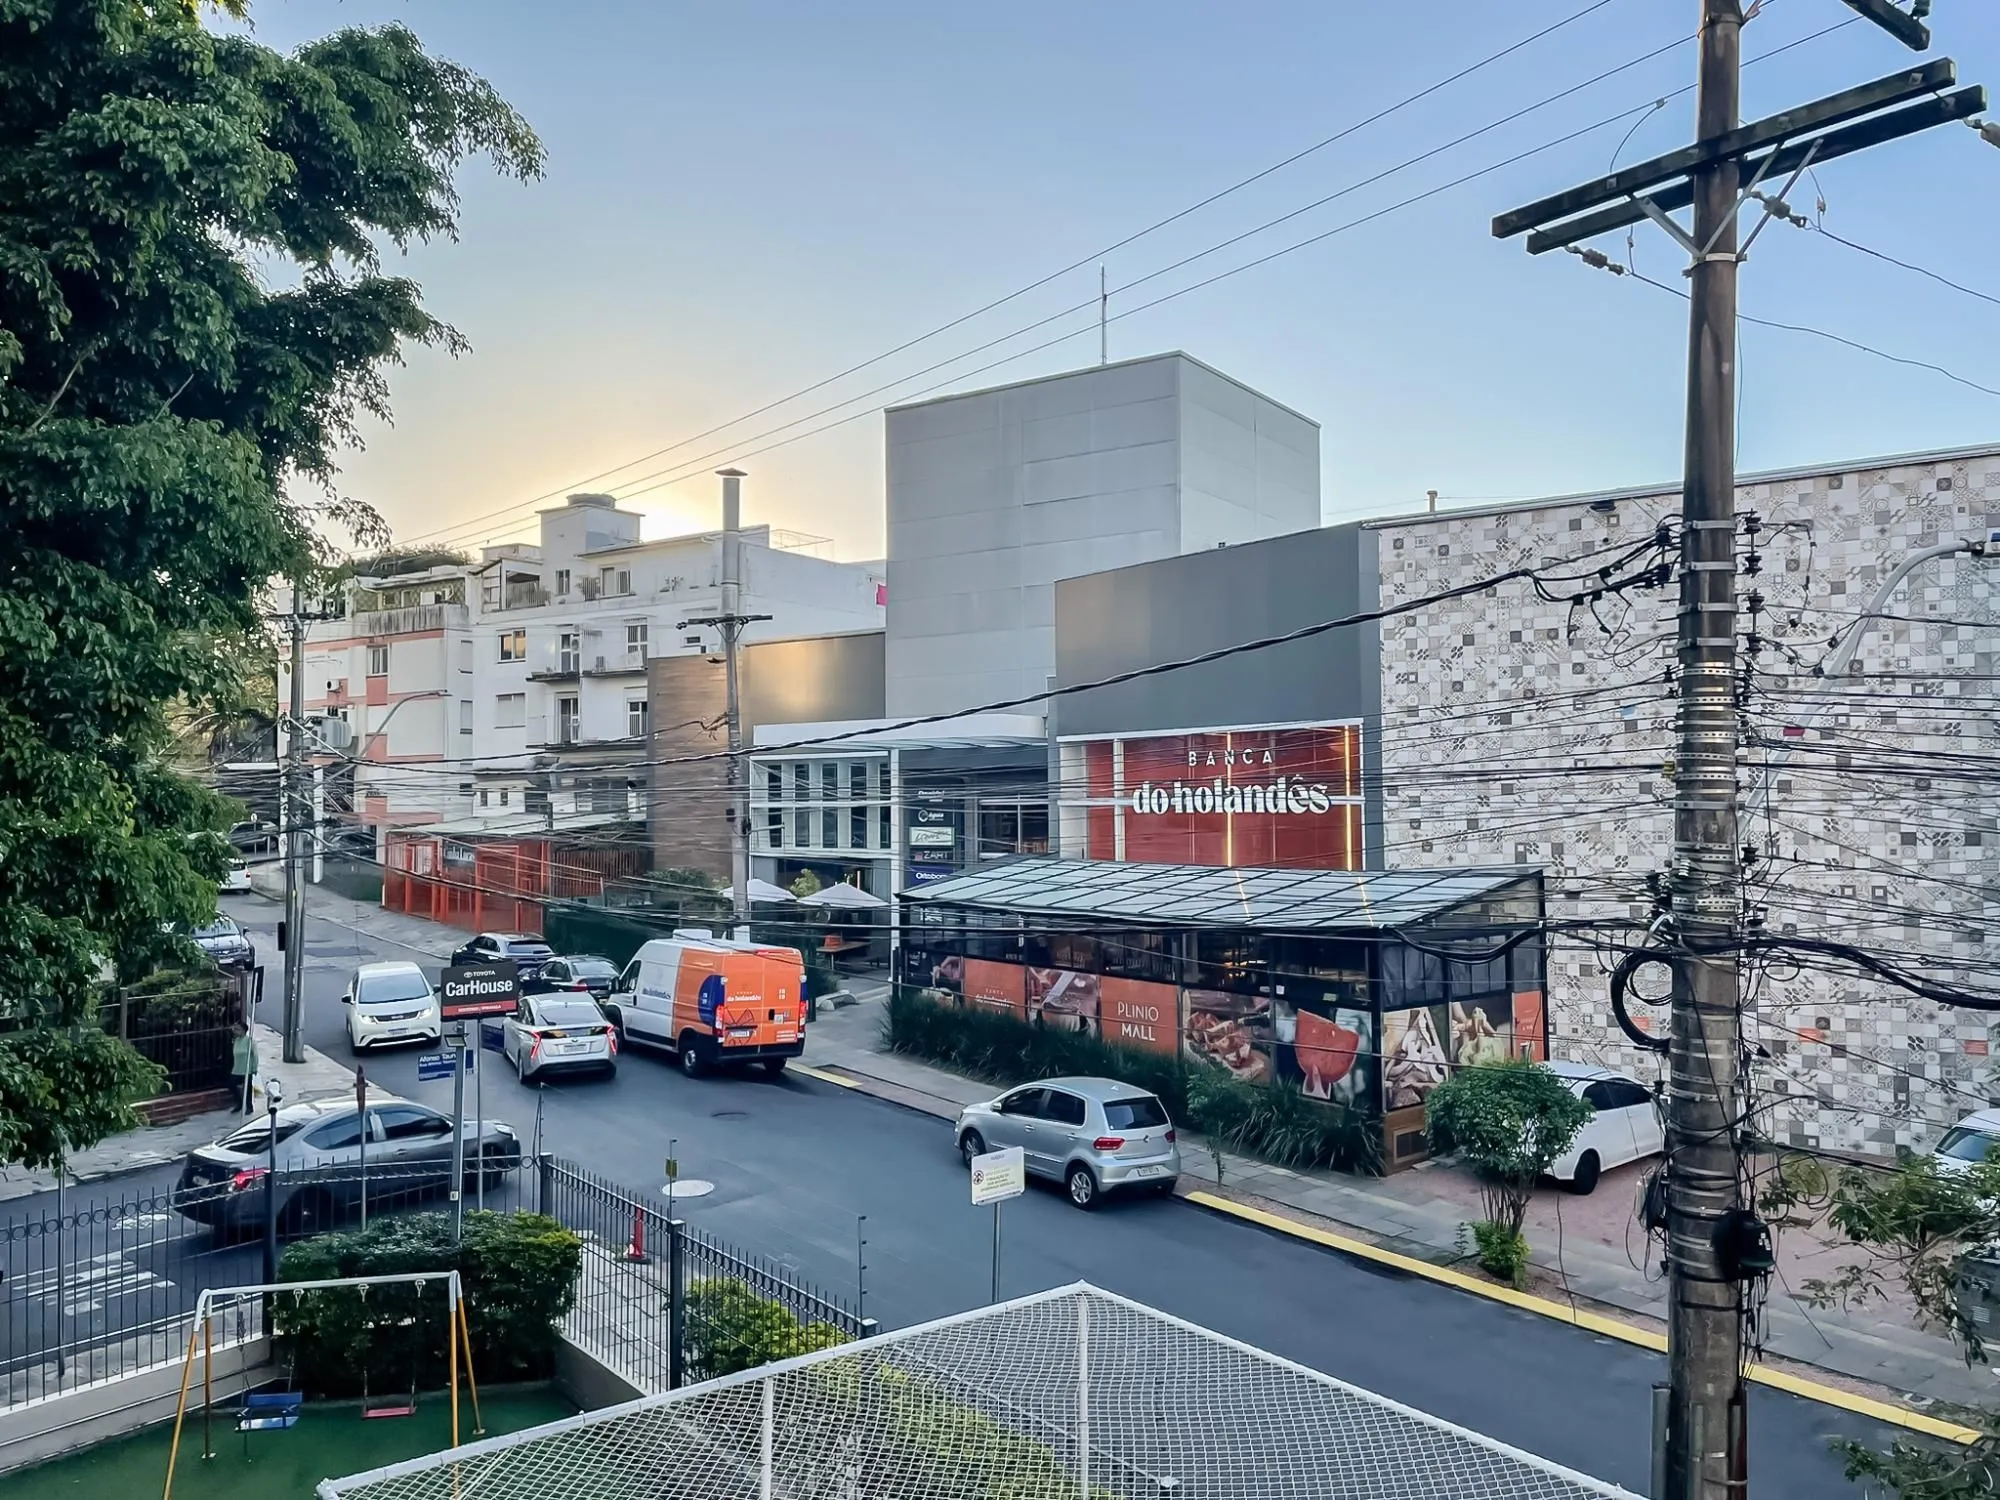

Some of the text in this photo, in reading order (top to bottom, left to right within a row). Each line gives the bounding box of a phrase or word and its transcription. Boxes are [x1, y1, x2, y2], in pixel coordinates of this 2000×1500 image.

[1188, 748, 1273, 767] BANCA
[1132, 774, 1331, 814] do holandês
[445, 980, 514, 997] CarHouse
[1117, 1001, 1159, 1021] PLINIO
[1121, 1023, 1156, 1041] MALL
